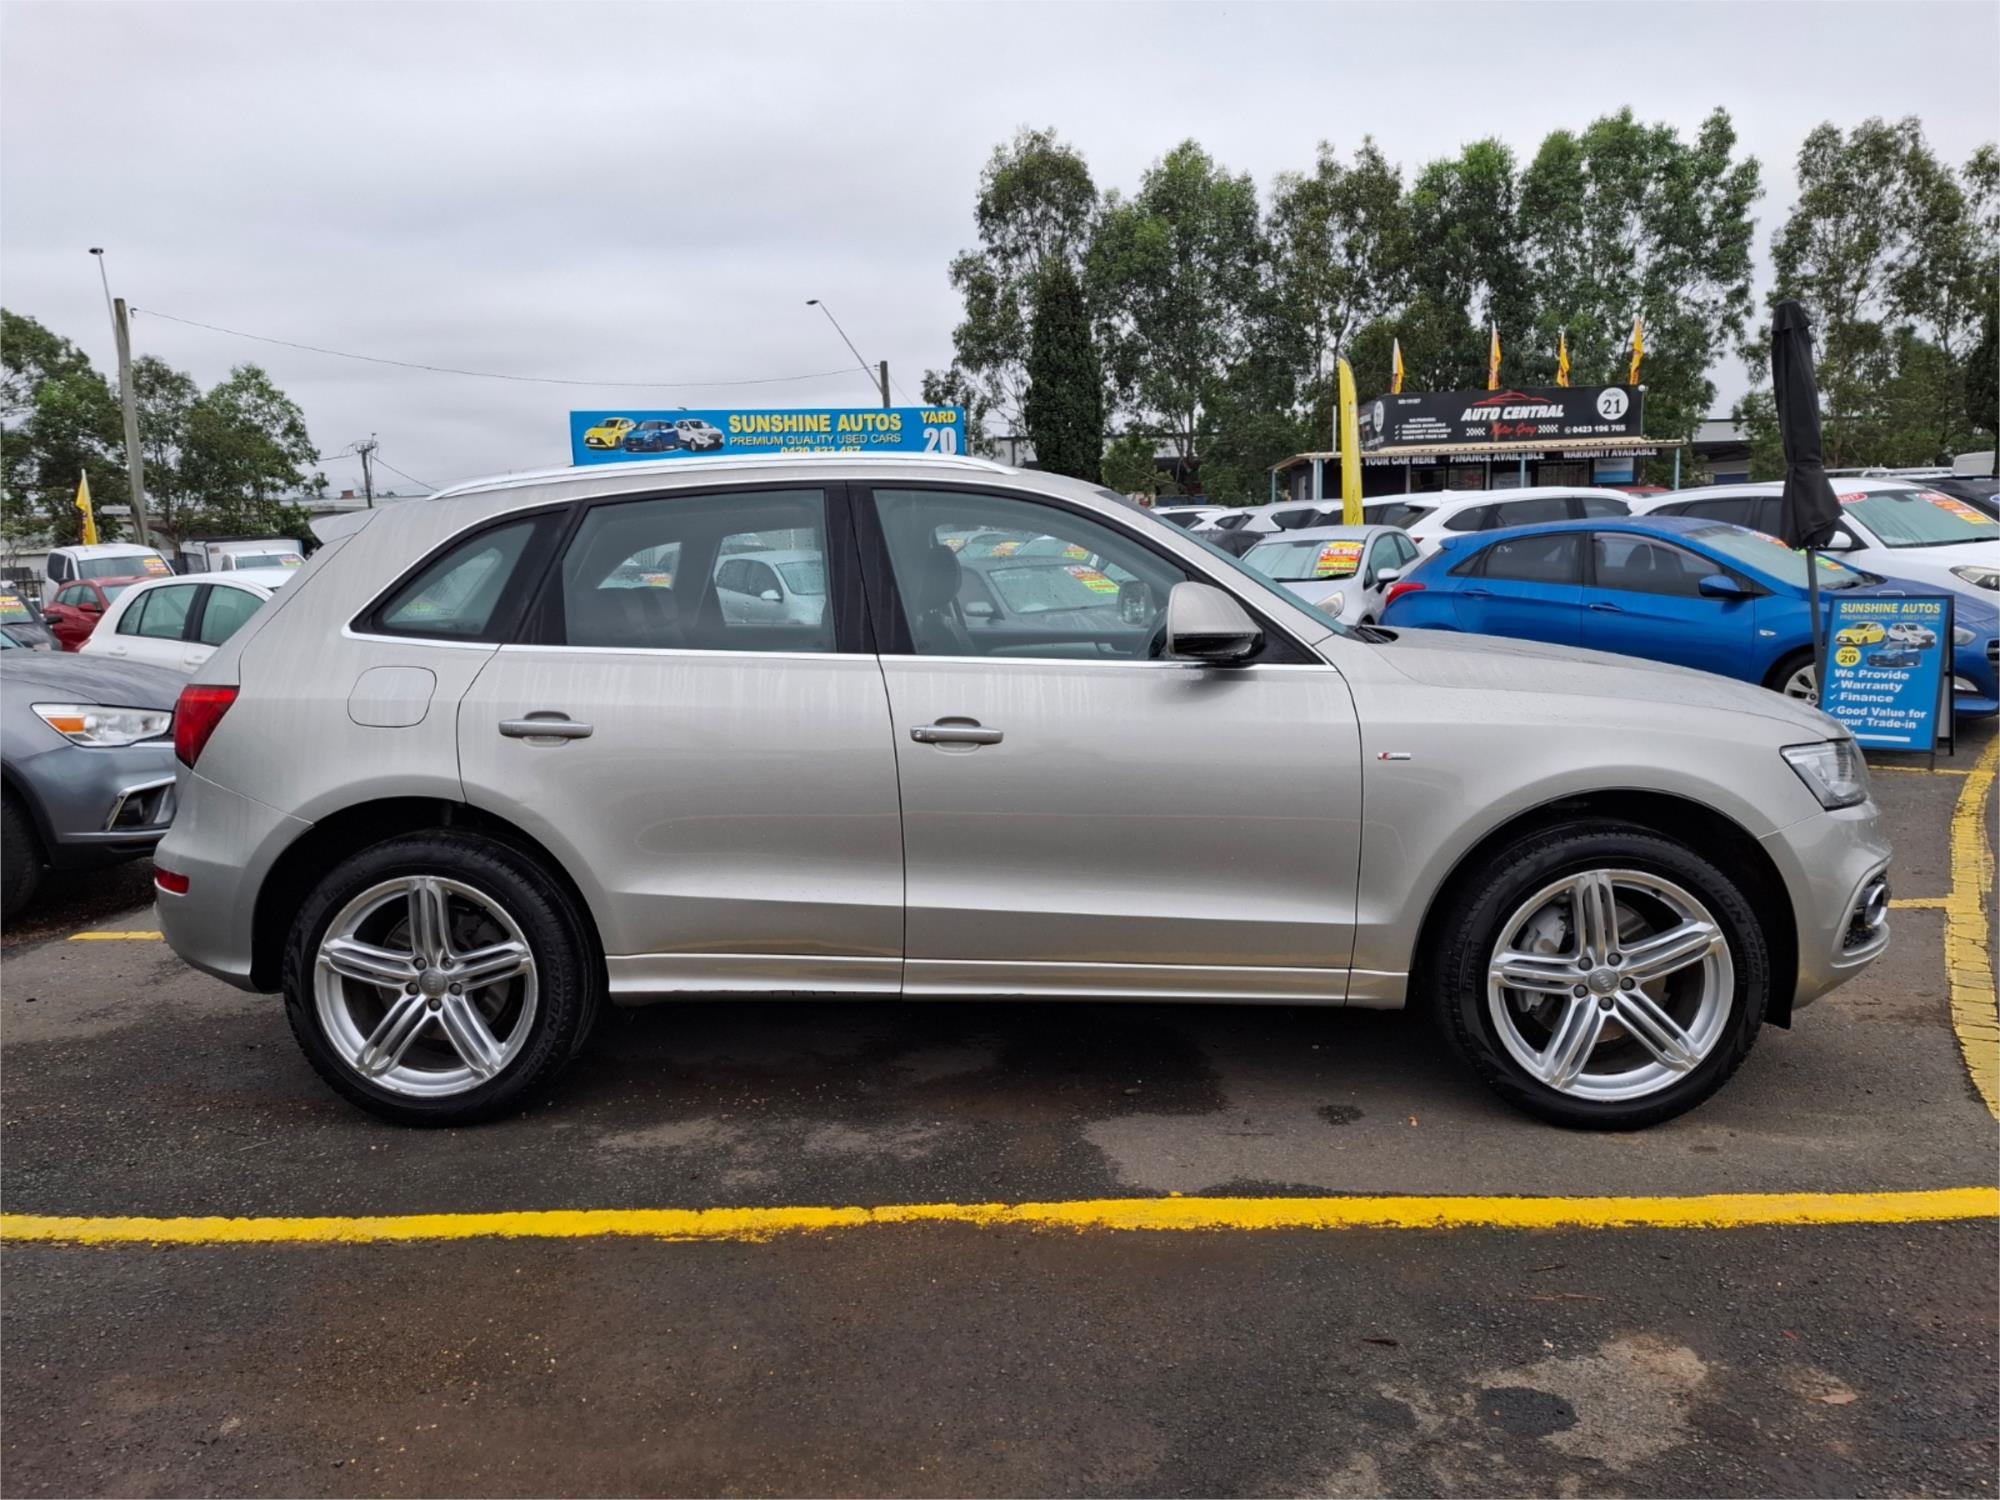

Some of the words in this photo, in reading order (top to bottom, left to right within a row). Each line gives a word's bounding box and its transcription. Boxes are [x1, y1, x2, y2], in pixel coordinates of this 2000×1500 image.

[1460, 407, 1501, 421] AUTO
[1502, 404, 1564, 420] CENTRAL
[1602, 398, 1621, 414] 21
[728, 413, 832, 433] SUNSHINE
[837, 412, 902, 432] AUTOS
[920, 410, 957, 424] YARD
[1572, 425, 1592, 433] 0423
[729, 435, 783, 446] PREMIUM
[786, 434, 835, 445] QUALITY
[836, 433, 868, 444] USED
[870, 432, 901, 443] CARS
[922, 426, 957, 455] 20
[1840, 602, 1898, 613] SUNSHINE
[1902, 603, 1941, 613] AUTOS
[1840, 654, 1856, 663] 20
[1834, 669, 1854, 678] We
[1858, 669, 1910, 680] Provide
[1840, 680, 1903, 693] Warranty
[1839, 693, 1894, 703] Finance
[1837, 705, 1867, 716] Good
[1871, 707, 1905, 718] Value
[1908, 709, 1927, 719] for
[1867, 718, 1916, 729] Trade-in
